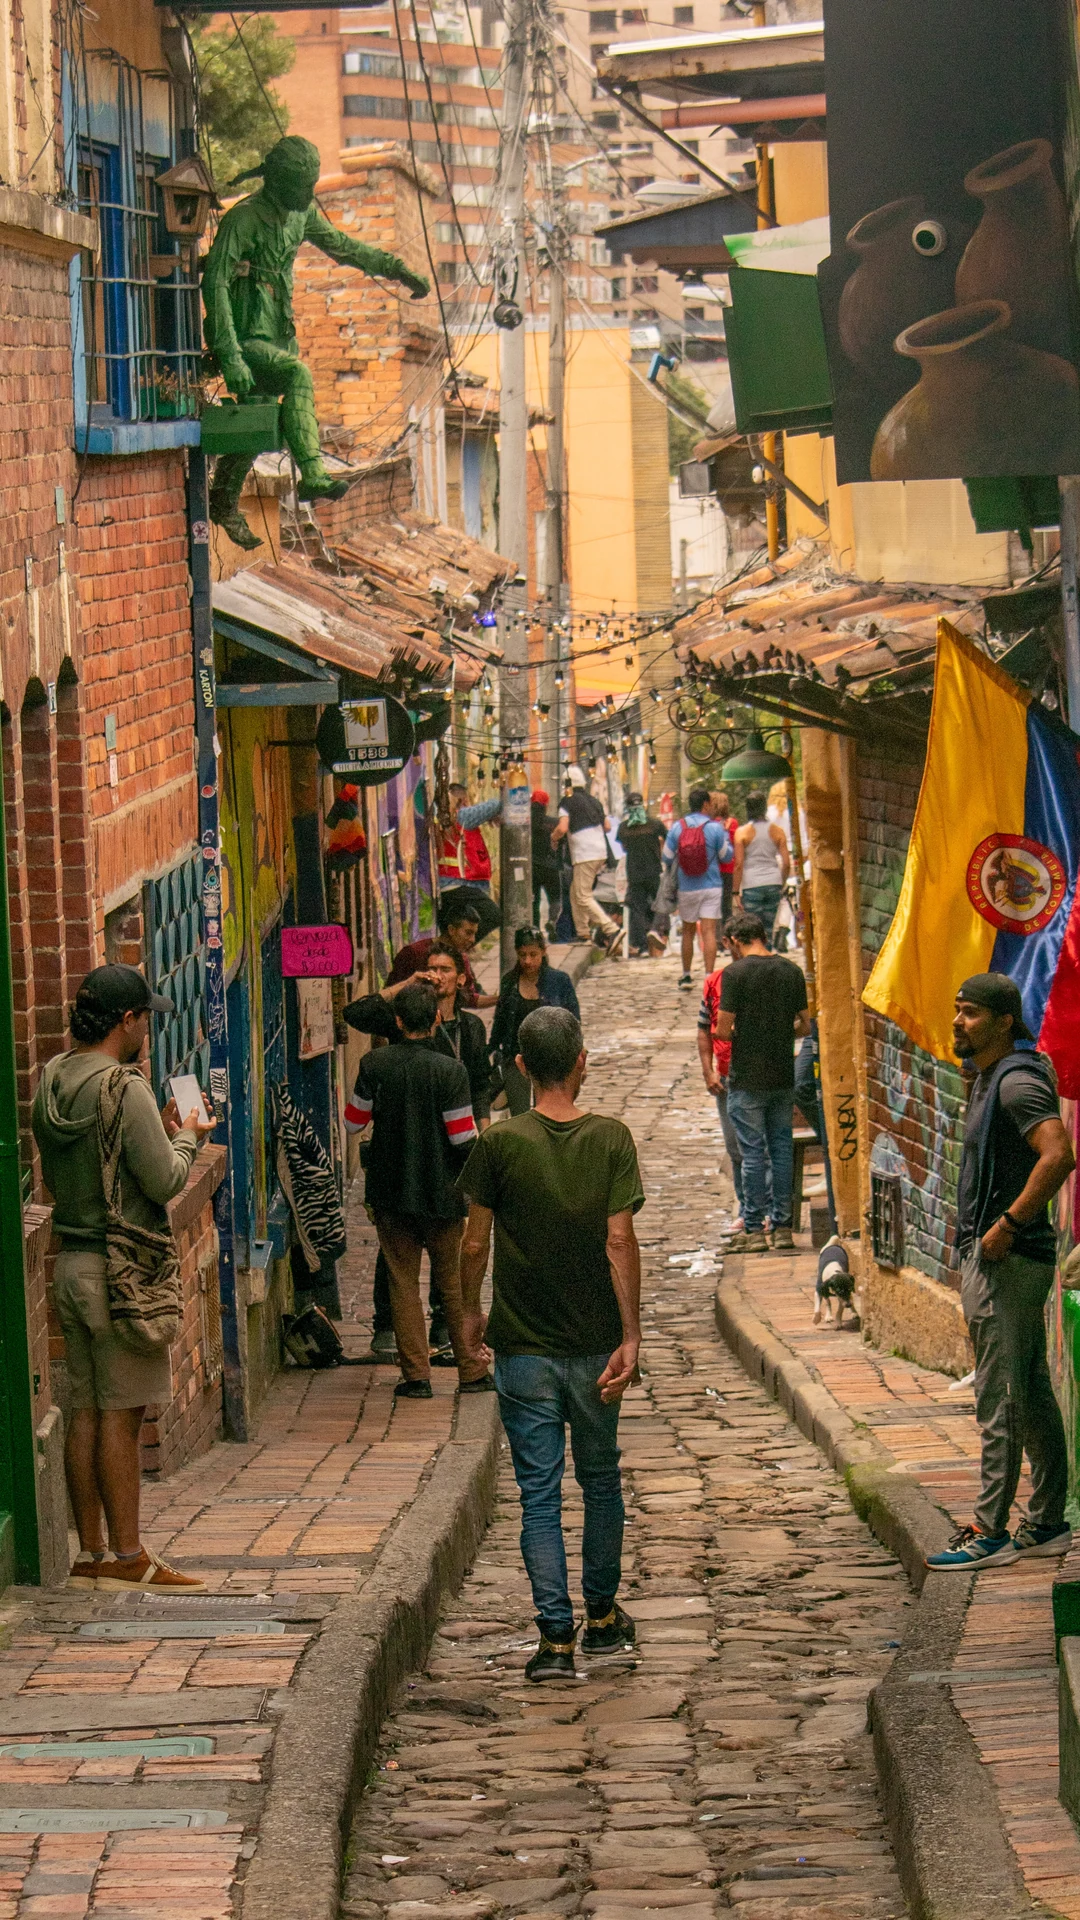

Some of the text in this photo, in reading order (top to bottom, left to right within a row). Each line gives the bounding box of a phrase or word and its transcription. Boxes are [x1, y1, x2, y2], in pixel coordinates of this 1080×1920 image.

[199, 669, 214, 708] KARTON
[348, 747, 388, 760] 1538
[333, 762, 362, 772] CHICHA
[971, 840, 1062, 931] REPUBLIC DE COLOMBIA
